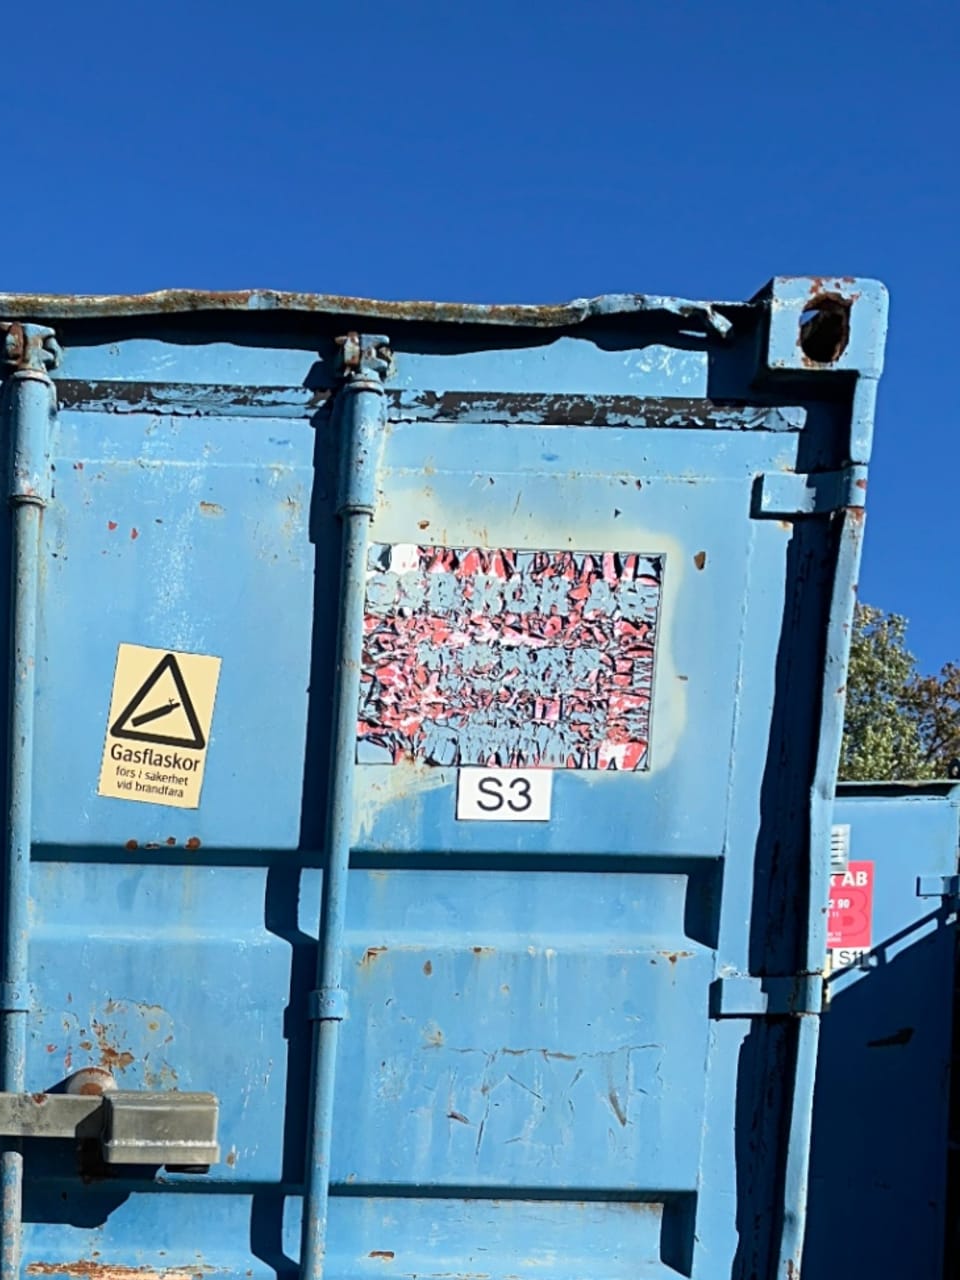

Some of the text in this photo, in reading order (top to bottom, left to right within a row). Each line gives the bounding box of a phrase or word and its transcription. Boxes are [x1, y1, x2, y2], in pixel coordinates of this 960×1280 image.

[110, 743, 201, 772] Gasflaskor
[117, 780, 184, 798] vid brandfara
[476, 777, 532, 812] S3
